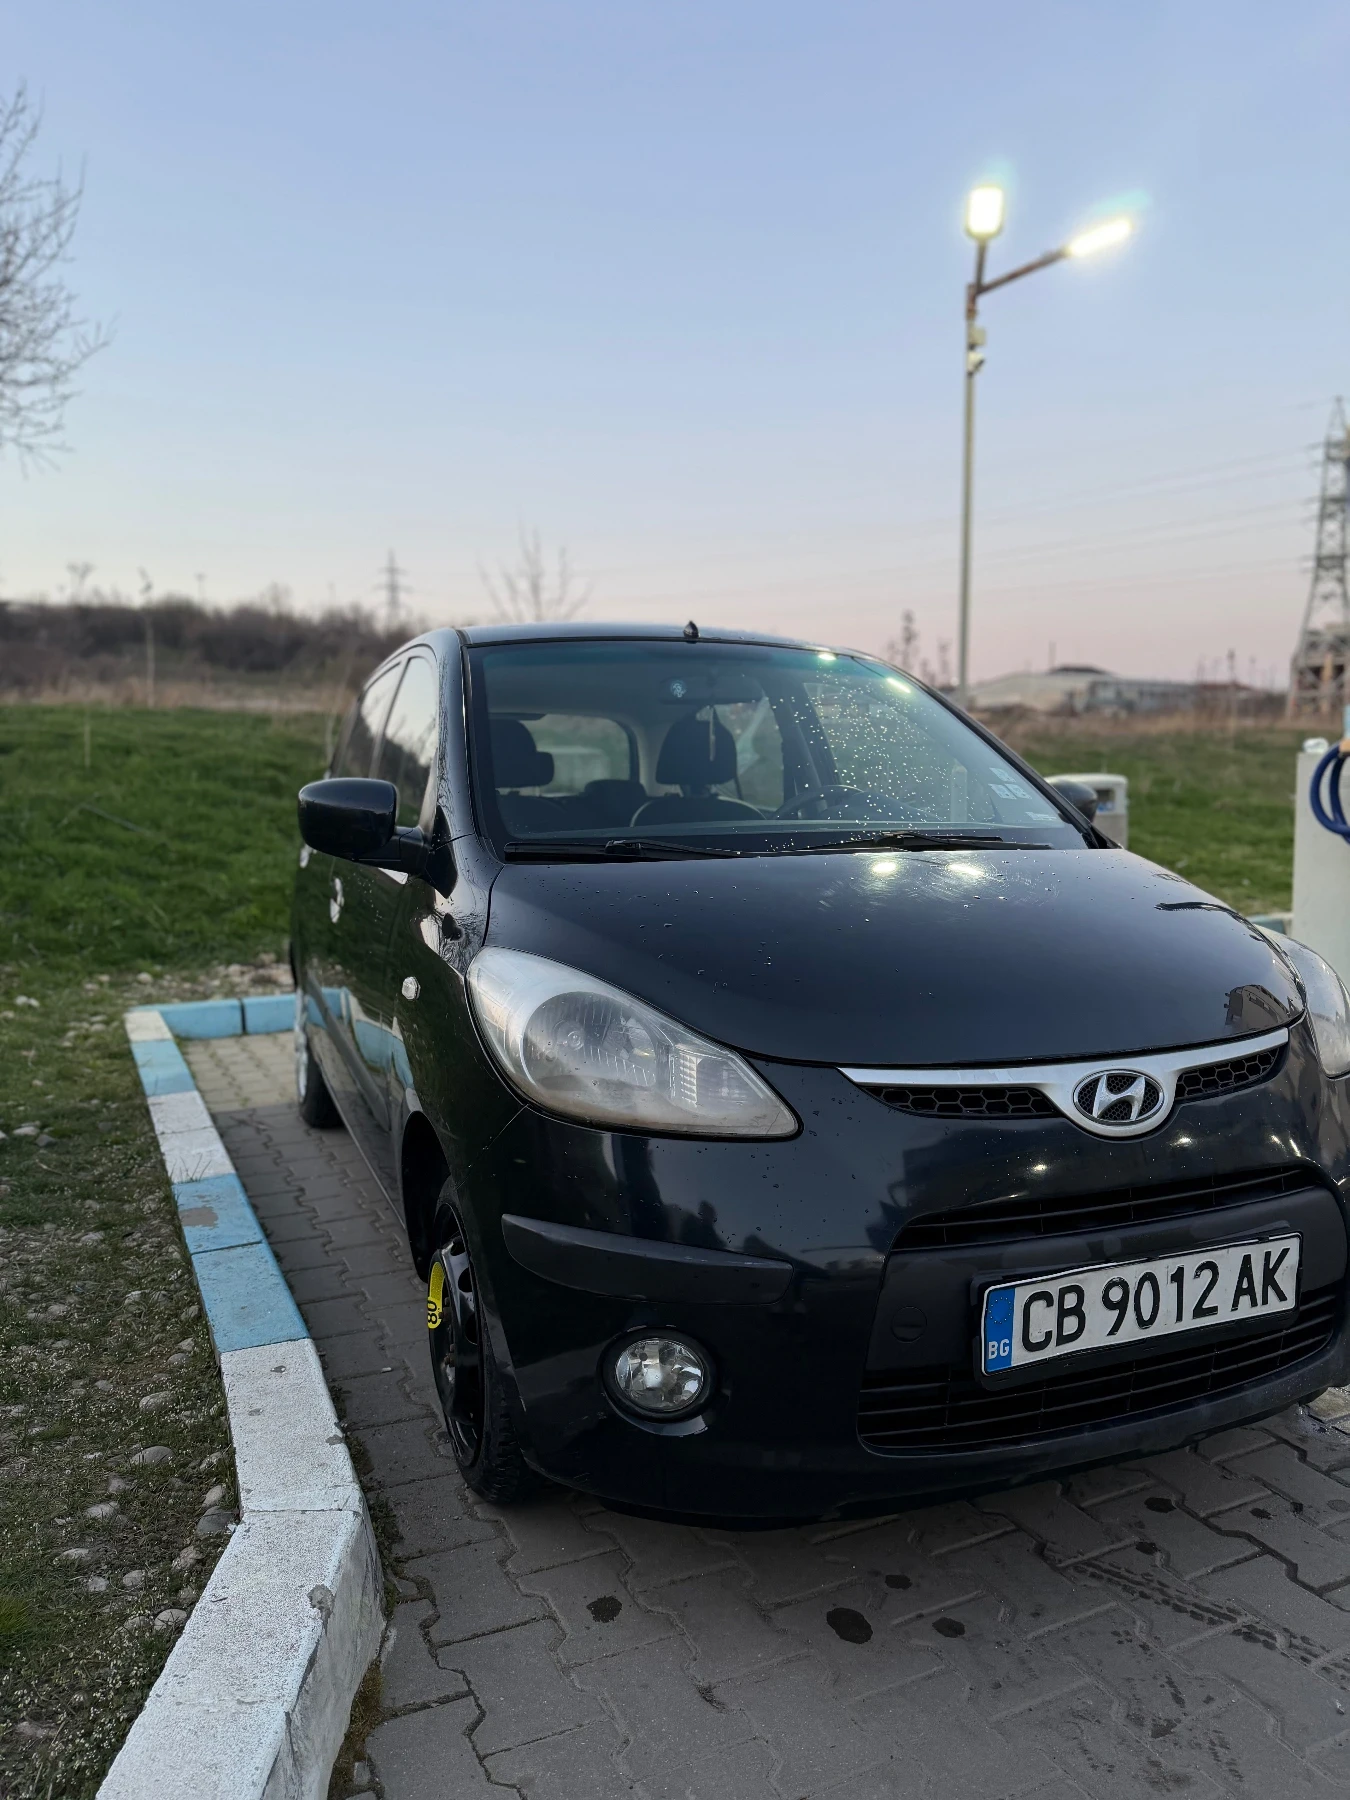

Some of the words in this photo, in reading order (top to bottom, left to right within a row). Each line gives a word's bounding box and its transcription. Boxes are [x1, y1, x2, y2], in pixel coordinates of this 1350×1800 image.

[1021, 1284, 1086, 1352] CB
[1101, 1260, 1219, 1336] 9012
[1230, 1247, 1291, 1312] AK
[988, 1338, 1010, 1359] BG
